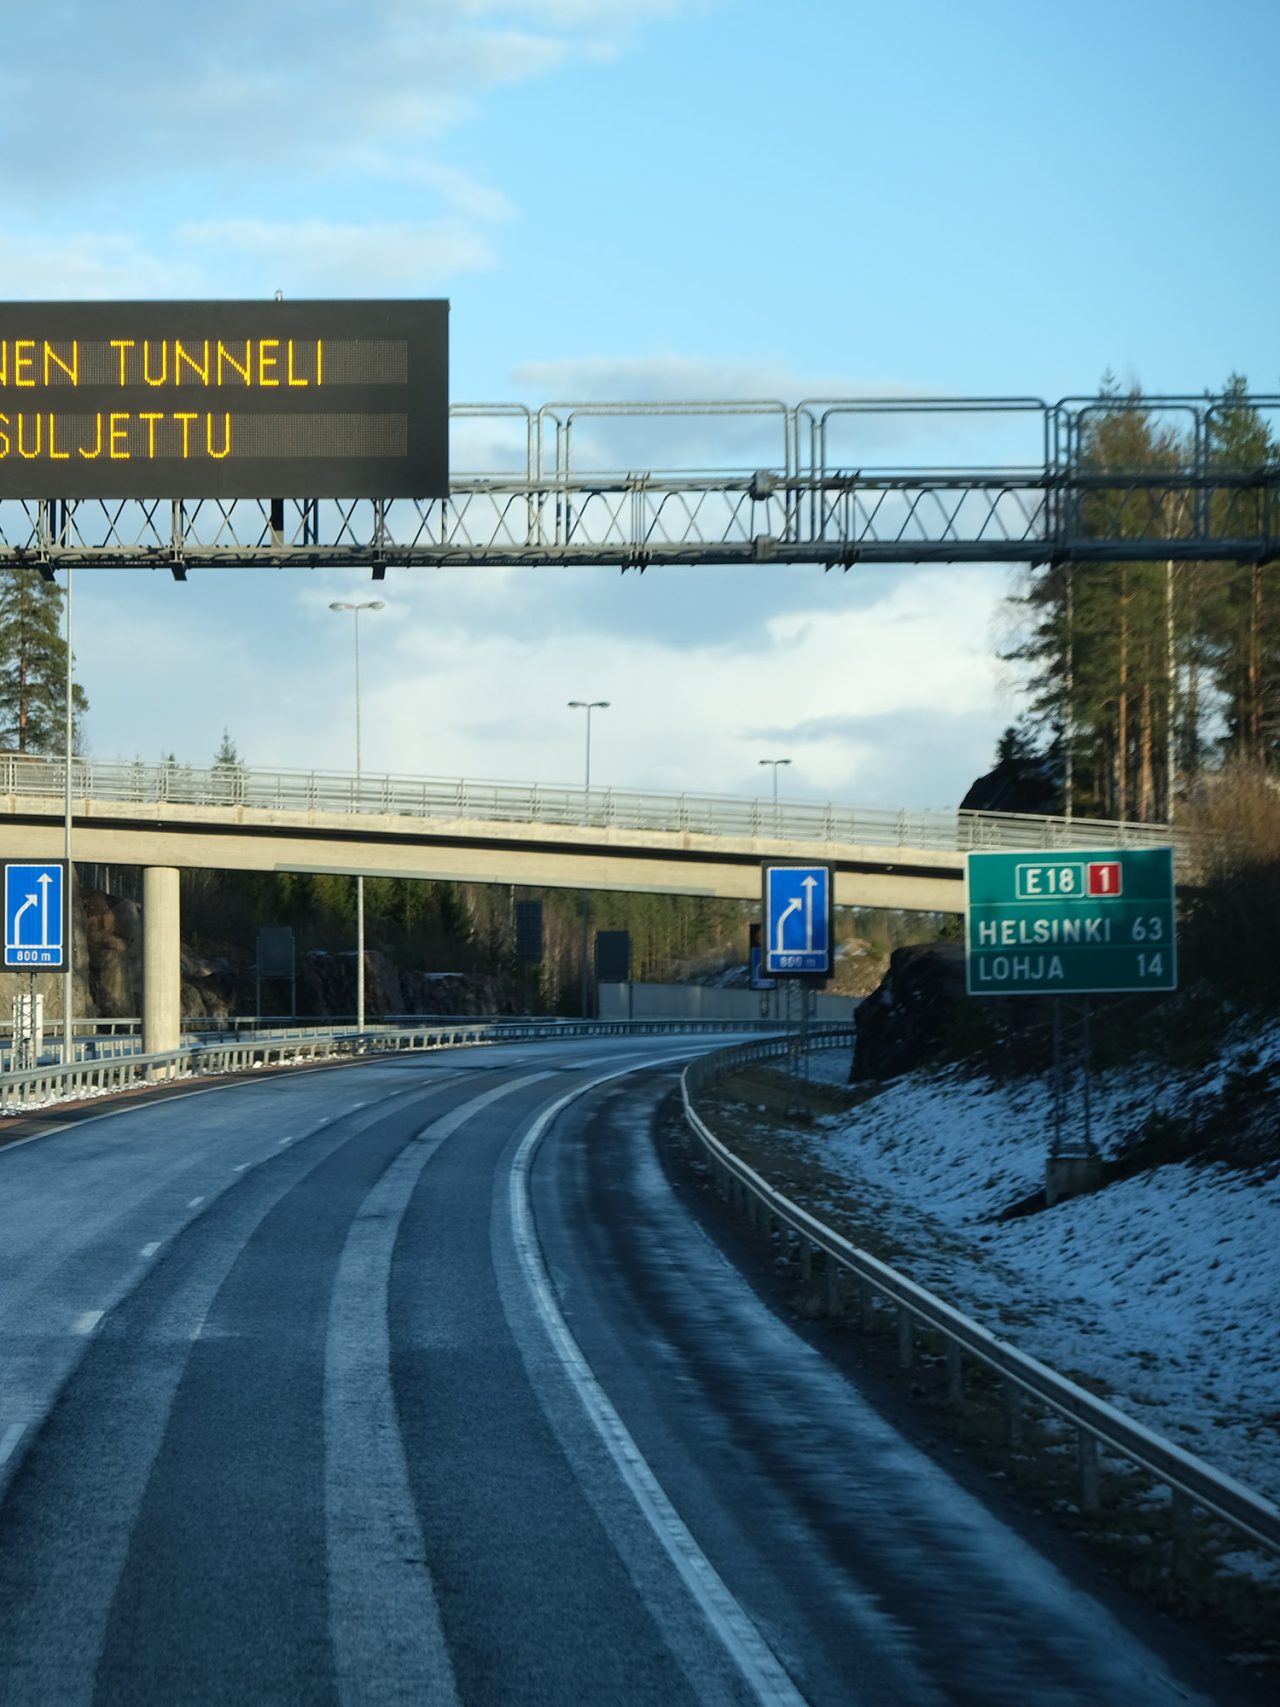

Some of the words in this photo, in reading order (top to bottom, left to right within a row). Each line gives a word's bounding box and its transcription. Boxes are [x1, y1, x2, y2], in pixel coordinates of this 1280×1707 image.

[109, 338, 322, 386] TUNNELI
[1025, 867, 1075, 894] E18
[1098, 866, 1110, 893] 1
[978, 918, 1111, 945] HELSINKI
[1131, 917, 1164, 942] 63
[16, 950, 38, 961] 800
[41, 952, 51, 961] m
[978, 955, 1065, 981] LOHJA
[1137, 953, 1164, 978] 14
